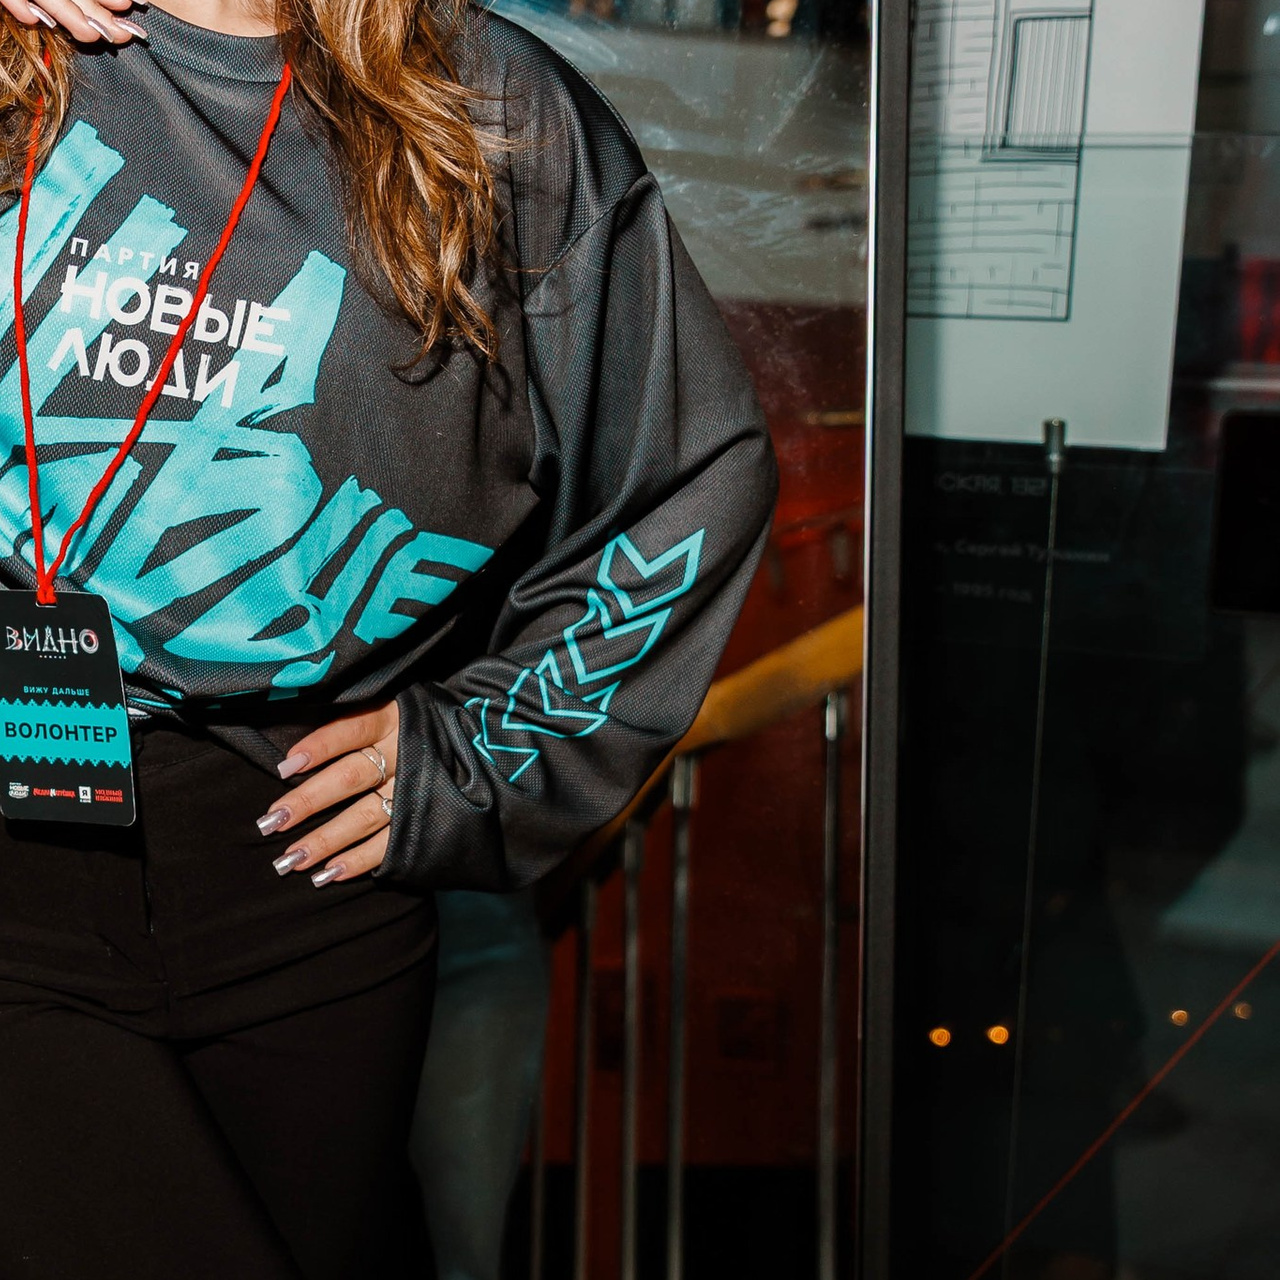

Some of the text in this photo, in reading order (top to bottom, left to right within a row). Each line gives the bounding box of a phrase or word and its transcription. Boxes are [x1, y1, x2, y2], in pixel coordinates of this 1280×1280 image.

[70, 237, 200, 280] ПАРТИЯ
[60, 265, 291, 356] НОВЫЕ
[48, 327, 240, 408] ЛЮДИ
[5, 625, 99, 655] ВИДНО
[23, 685, 90, 697] ВИЖУ ДАЛЬШЕ
[5, 721, 118, 743] ВОЛОНТЕР
